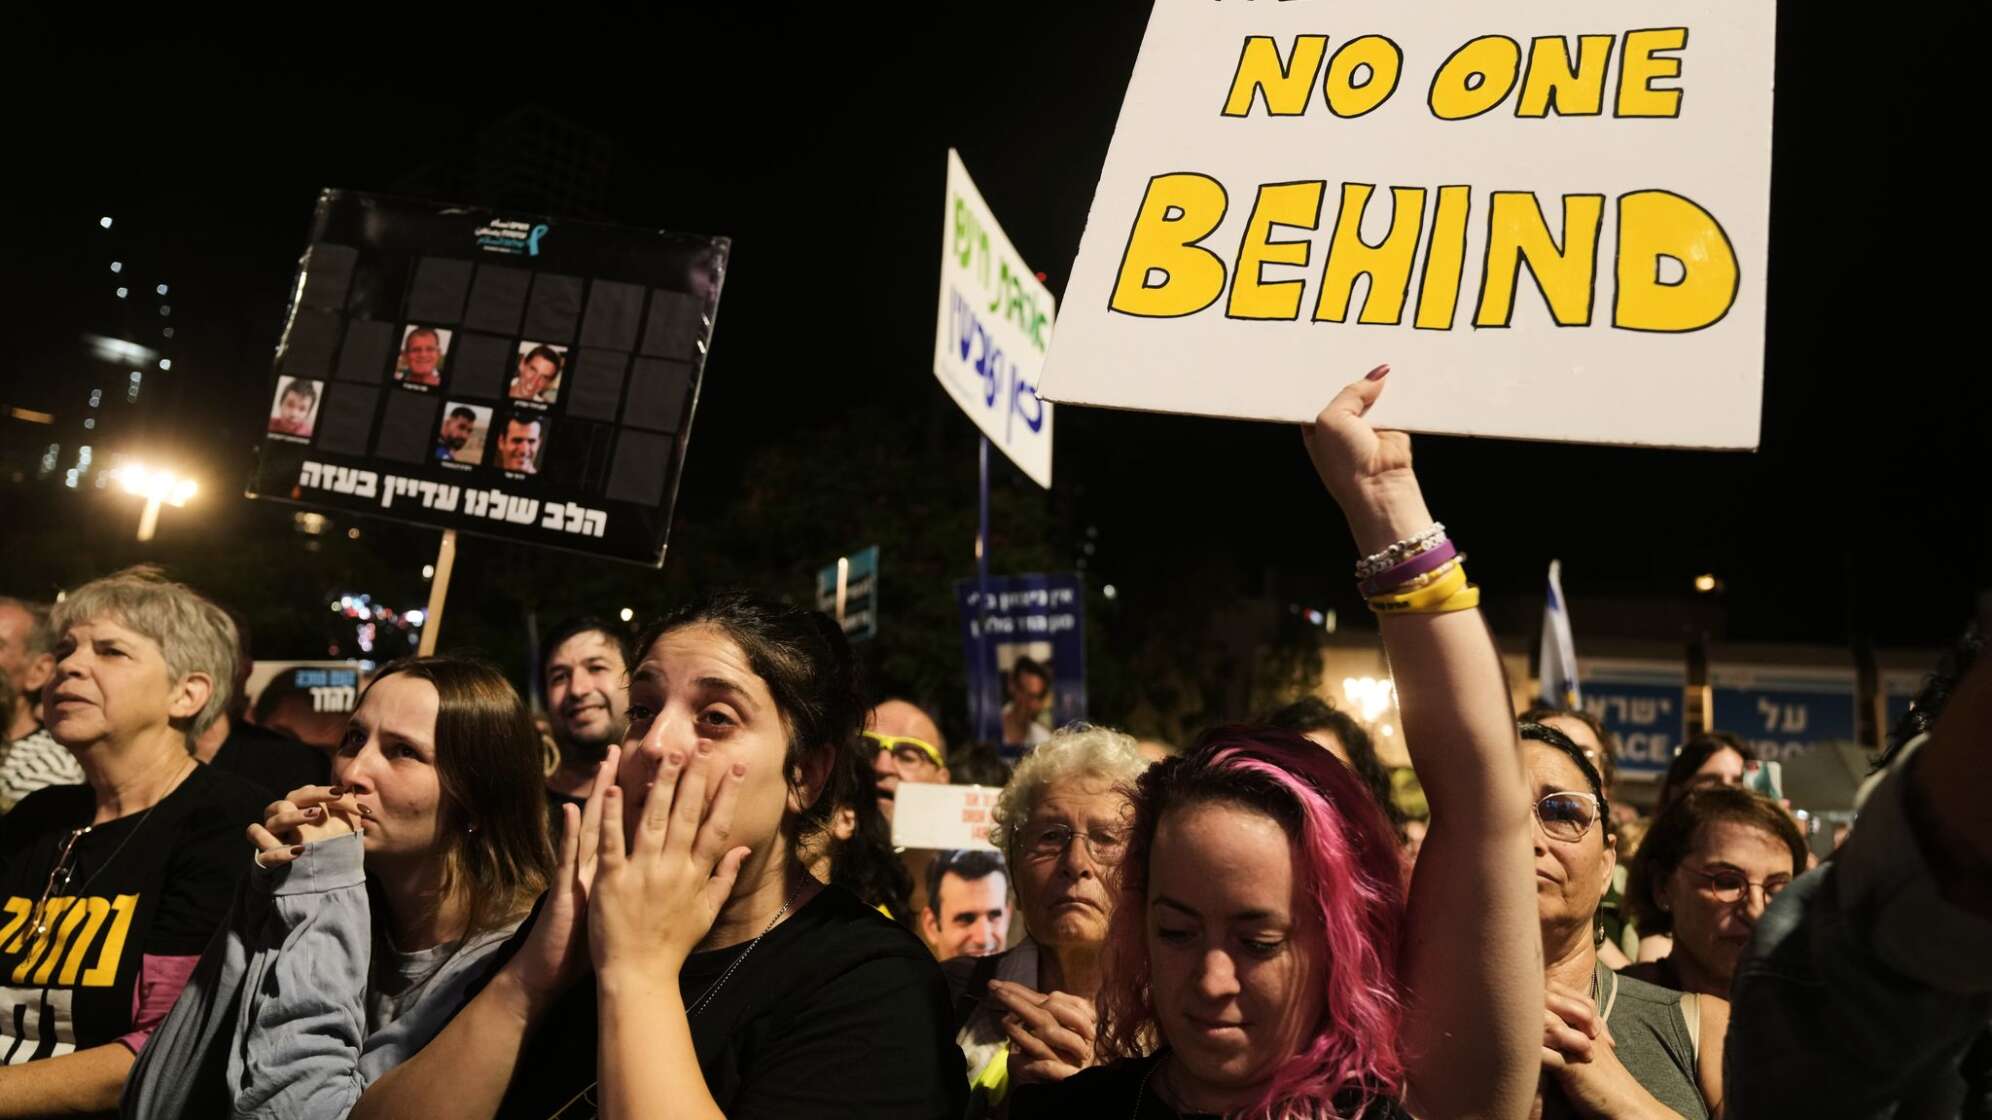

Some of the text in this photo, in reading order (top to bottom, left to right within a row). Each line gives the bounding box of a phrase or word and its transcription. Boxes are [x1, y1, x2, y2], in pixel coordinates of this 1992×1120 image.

[1221, 27, 1689, 121] NO ONE
[1108, 172, 1740, 333] BEHIND
[300, 460, 607, 538] הלב שלנו עדיין בעזה
[1585, 696, 1671, 723] ישרא
[1610, 732, 1670, 764] ACE
